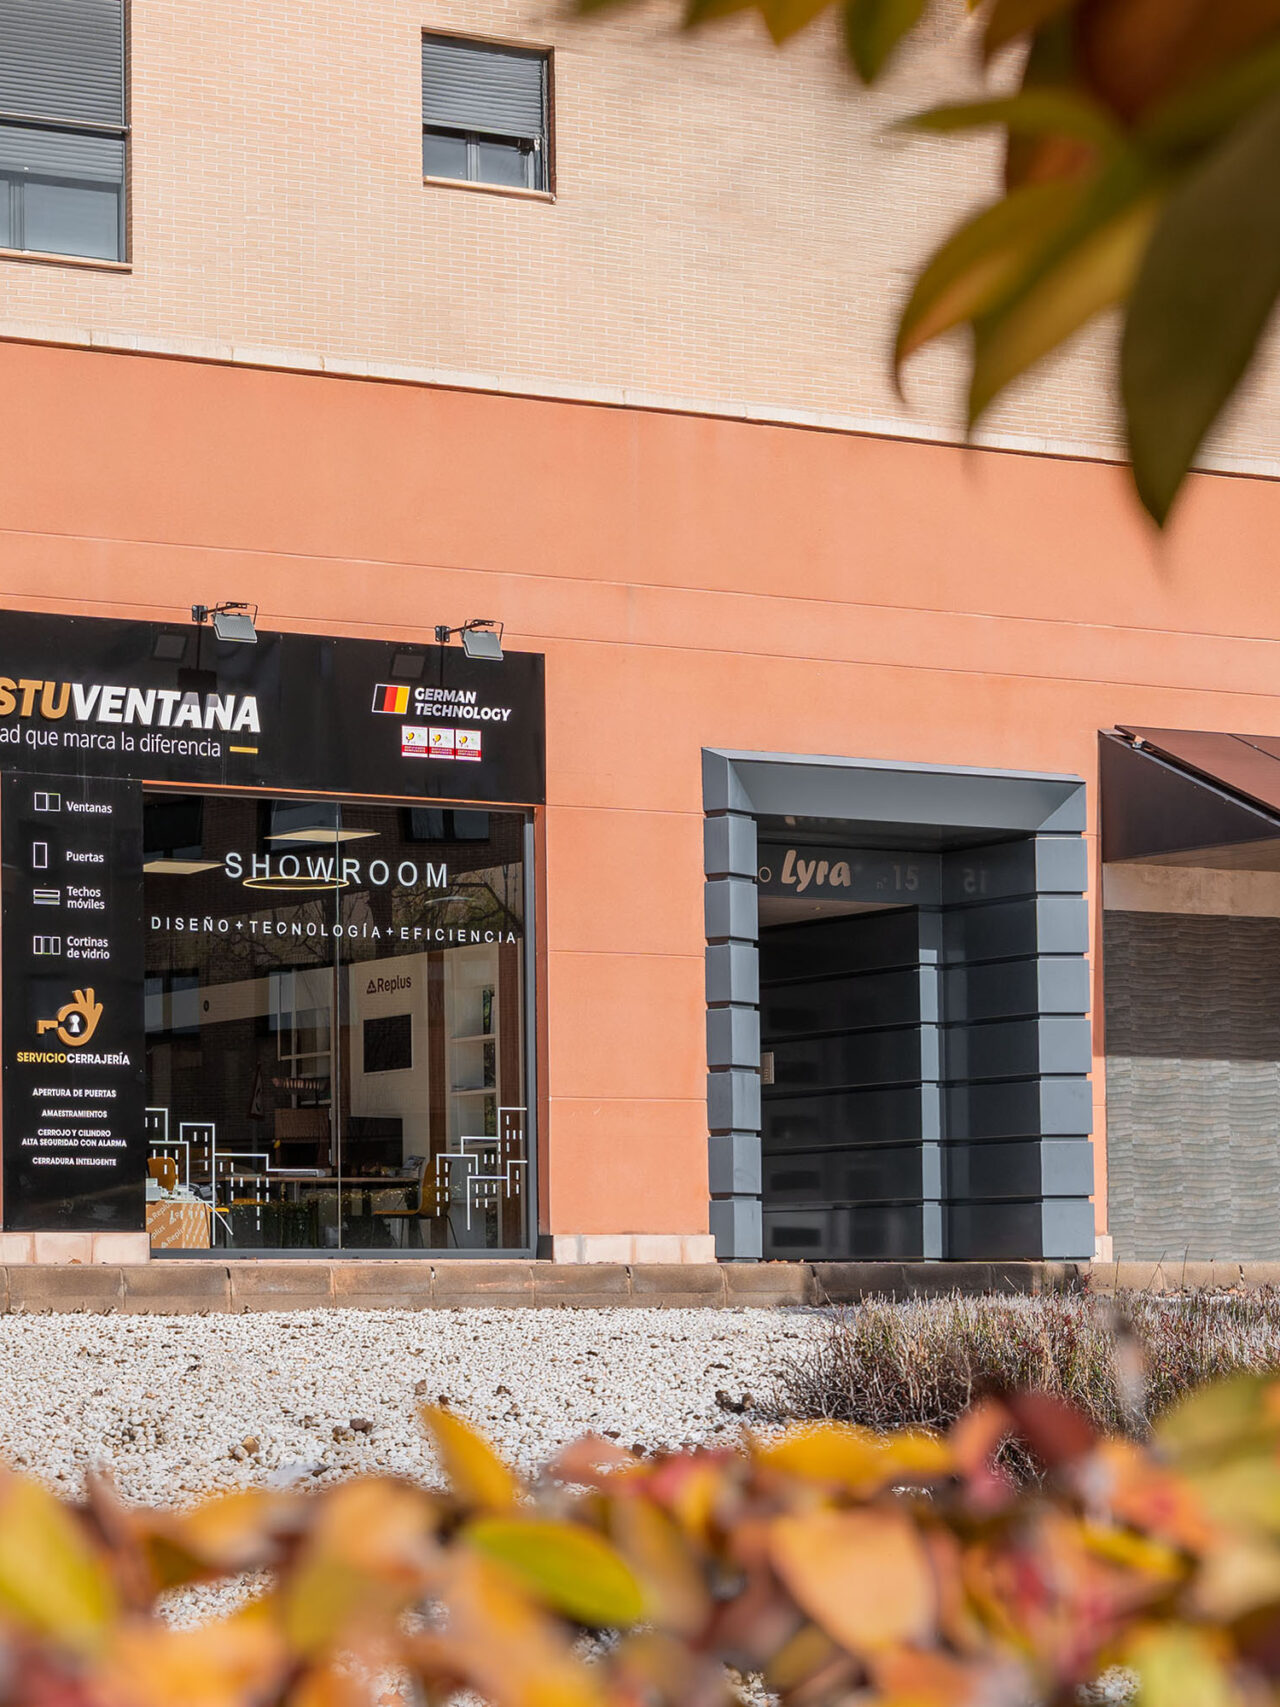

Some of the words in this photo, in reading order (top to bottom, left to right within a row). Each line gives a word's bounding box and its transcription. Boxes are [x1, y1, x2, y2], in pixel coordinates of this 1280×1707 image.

[415, 687, 477, 704] GERMAN
[415, 703, 512, 722] TECHNOLOGY
[25, 729, 58, 749] que
[63, 732, 116, 751] marca
[121, 731, 135, 751] la
[139, 732, 221, 758] diferencia
[66, 801, 112, 814] Ventanas
[66, 851, 104, 863] Puertas
[224, 852, 449, 889] SHOWROOM
[781, 849, 851, 892] Lyra
[66, 886, 101, 897] Techos
[67, 898, 105, 910] móviles
[151, 916, 229, 933] DISEÑO
[249, 919, 380, 939] TECNOLOGÍA
[400, 927, 516, 944] EFICIENCIA
[67, 936, 108, 948] Cortinas
[67, 948, 81, 958] de
[81, 948, 110, 960] vidrio
[377, 975, 411, 995] Replus
[17, 1051, 130, 1065] SERVICIOCERRAJERÍA
[32, 1088, 71, 1098] APERTURA
[72, 1089, 83, 1098] DE
[84, 1089, 117, 1098] PUERTAS
[41, 1109, 108, 1119] AMAESTRAMIENTOS
[37, 1129, 71, 1137] CERROJO
[77, 1130, 111, 1138] CILINDRO
[21, 1138, 39, 1147] ALTA
[39, 1138, 79, 1147] SEGURIDAD
[80, 1139, 97, 1148] CON
[97, 1139, 127, 1148] ALARMA
[32, 1157, 75, 1166] CERRADURA
[75, 1158, 117, 1167] INTELIGENTE
